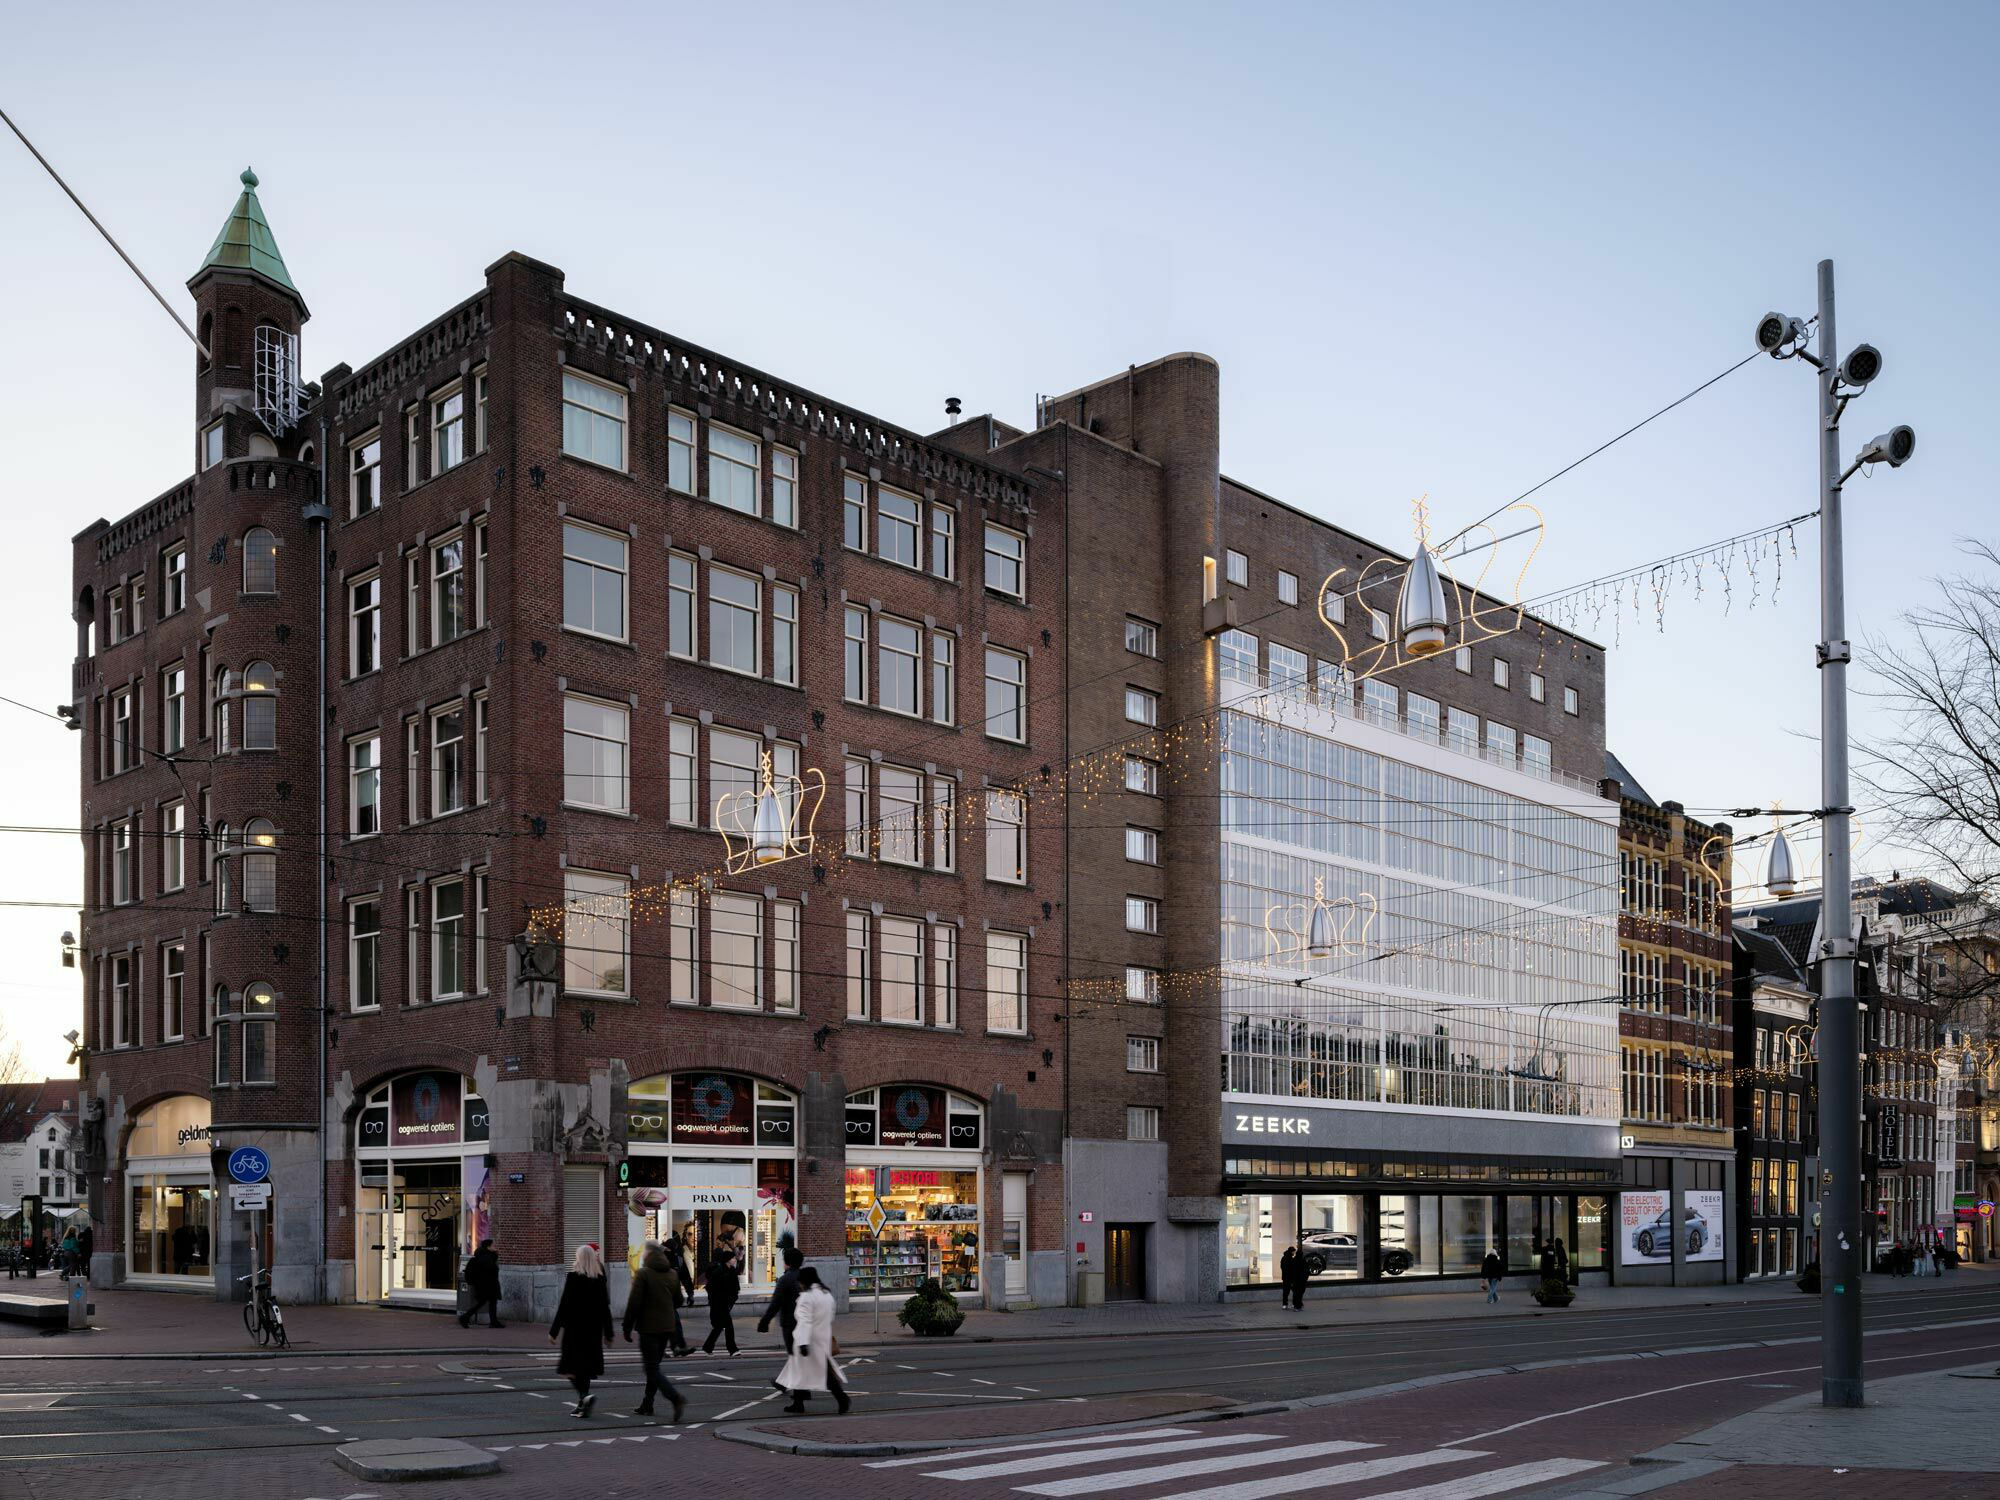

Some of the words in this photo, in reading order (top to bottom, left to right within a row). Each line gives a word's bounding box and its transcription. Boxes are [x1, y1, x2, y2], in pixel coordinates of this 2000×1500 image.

[398, 1123, 429, 1135] oogwereld
[430, 1122, 455, 1133] optilens
[676, 1124, 717, 1132] oogwereld
[719, 1124, 749, 1133] optilens
[1235, 1115, 1311, 1134] ZEEKR
[882, 1131, 915, 1139] oogwereld
[917, 1131, 942, 1140] optilens
[1885, 1106, 1896, 1157] HOTEL
[692, 1194, 733, 1203] PRADA
[1623, 1195, 1635, 1204] THE
[1636, 1195, 1663, 1205] ELECTRIC
[1700, 1195, 1721, 1203] ZEEKR
[1623, 1206, 1642, 1215] DEBUT
[1643, 1206, 1651, 1215] OF
[1652, 1205, 1663, 1215] THE
[1577, 1215, 1601, 1223] ZEEKR
[1623, 1216, 1639, 1225] YEAR
